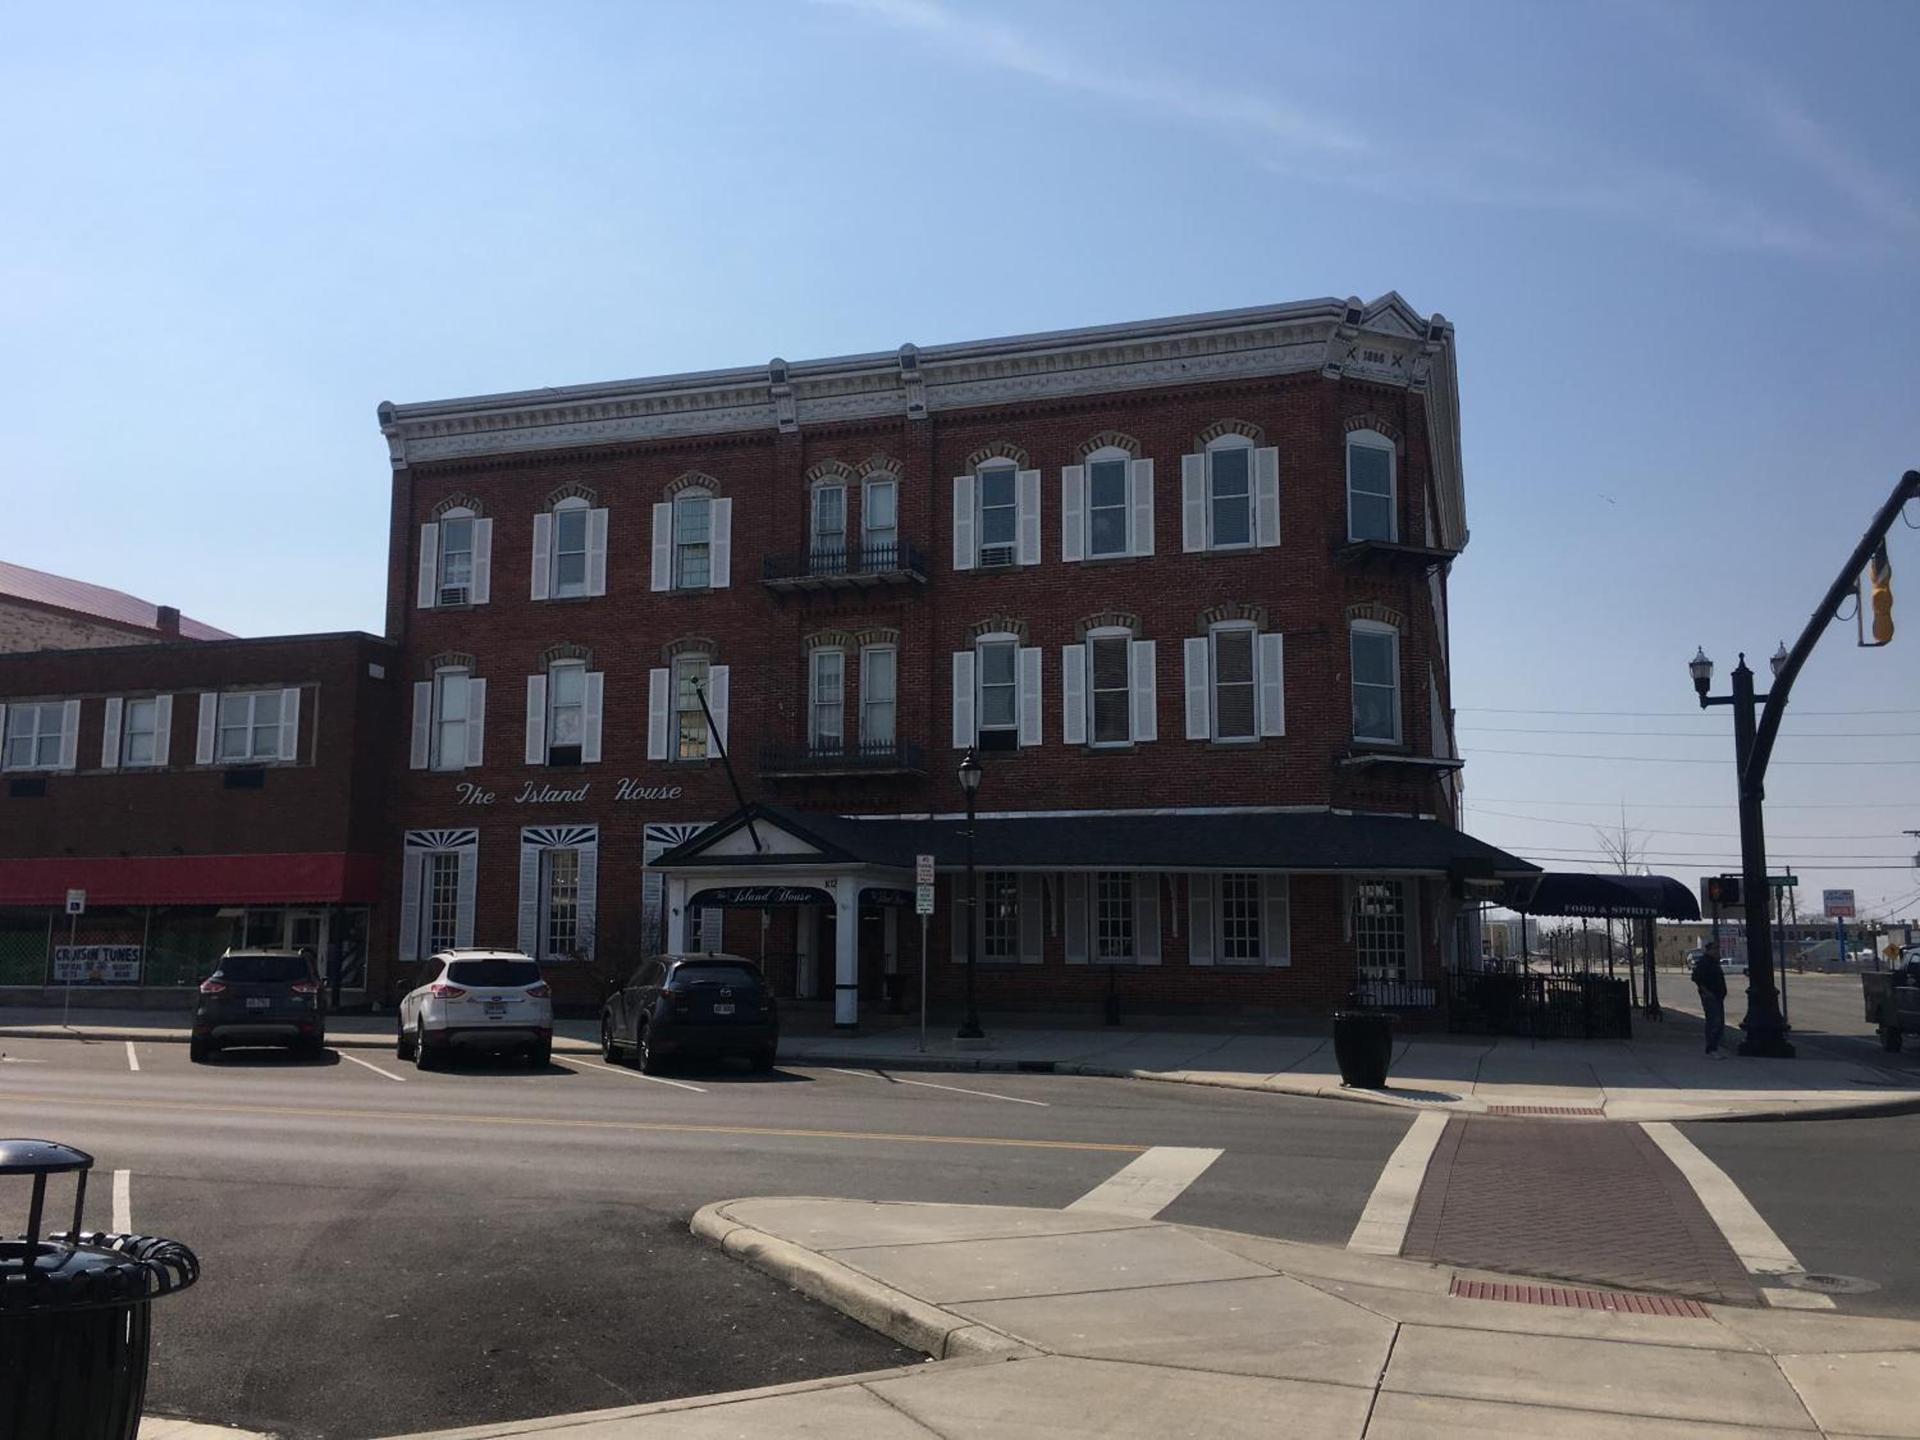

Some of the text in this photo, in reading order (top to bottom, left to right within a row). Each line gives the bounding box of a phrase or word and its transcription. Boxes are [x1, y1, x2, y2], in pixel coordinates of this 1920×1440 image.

[456, 777, 683, 806] The Island House
[734, 887, 773, 903] Island
[775, 886, 812, 902] House
[1563, 902, 1596, 913] FOOD
[1610, 904, 1658, 915] SPIRITS
